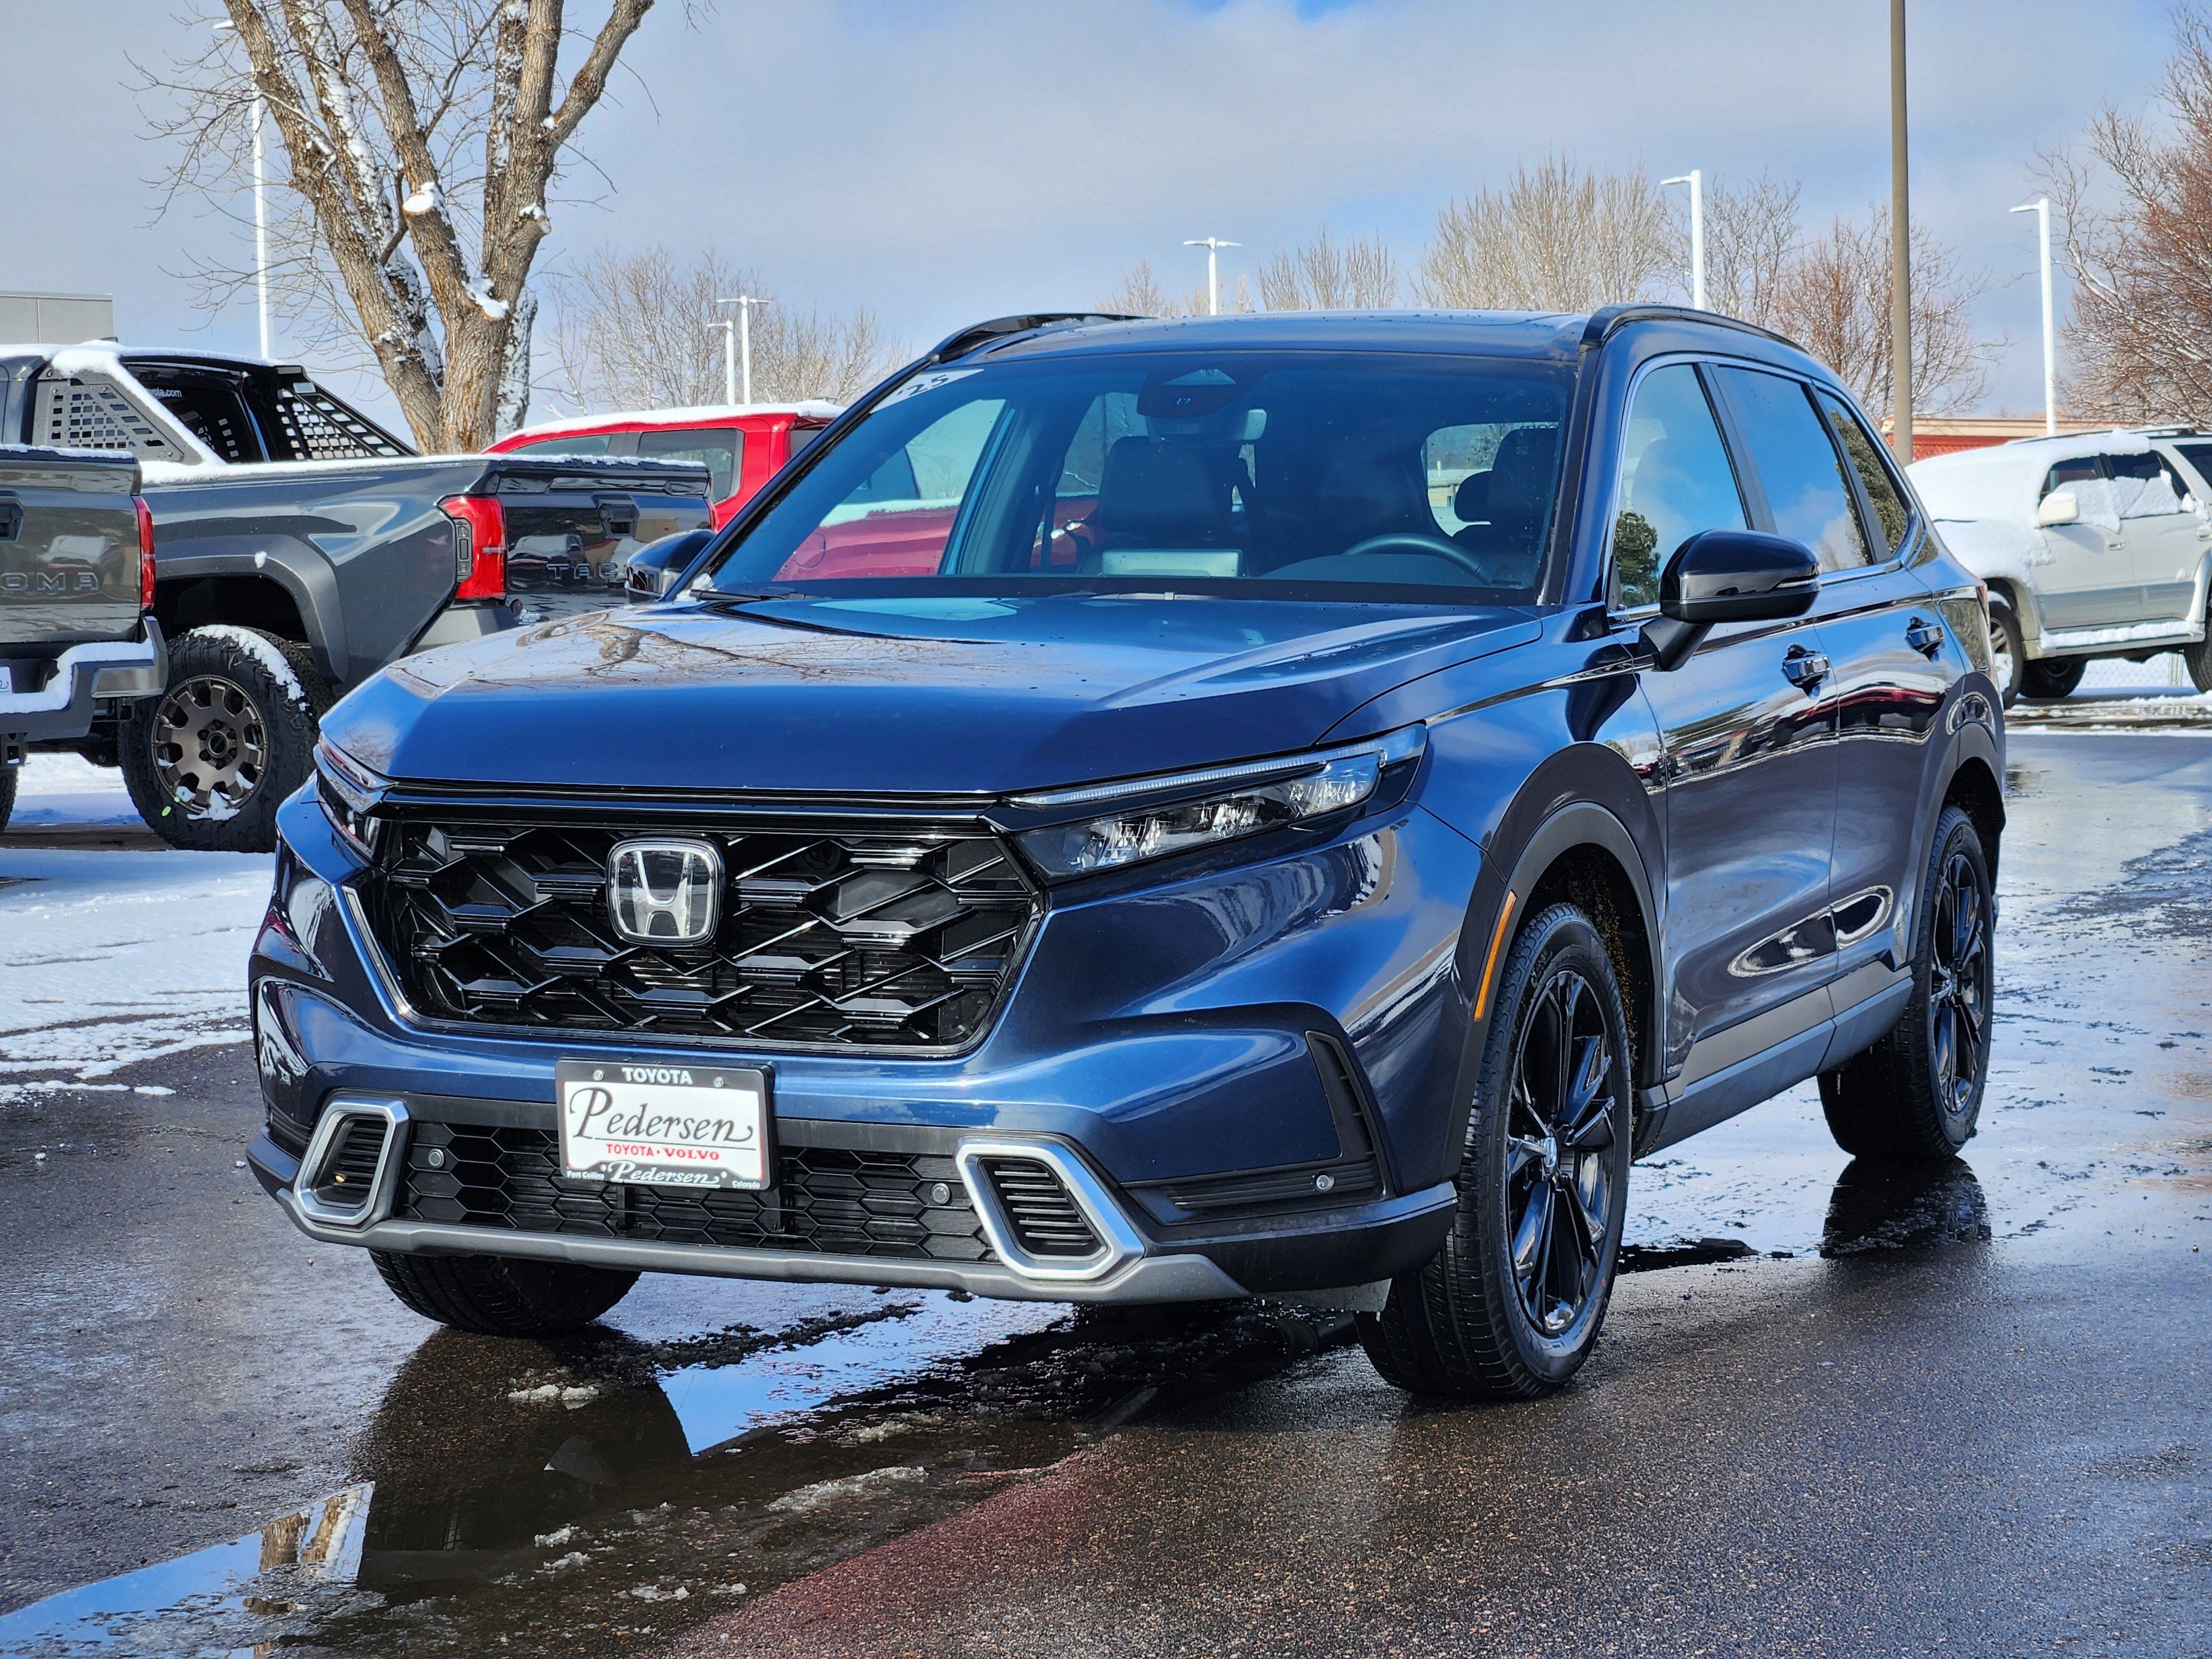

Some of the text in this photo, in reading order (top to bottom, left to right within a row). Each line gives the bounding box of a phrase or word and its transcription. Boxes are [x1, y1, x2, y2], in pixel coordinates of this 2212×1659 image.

[546, 563, 628, 580] TAC
[622, 1067, 693, 1085] TOYOTA
[570, 1087, 754, 1142] Pedersen
[606, 1143, 720, 1161] TOYOTA VOLVO
[566, 1170, 581, 1179] Fort
[607, 1159, 720, 1184] Pedersen
[732, 1180, 761, 1190] Colorado
